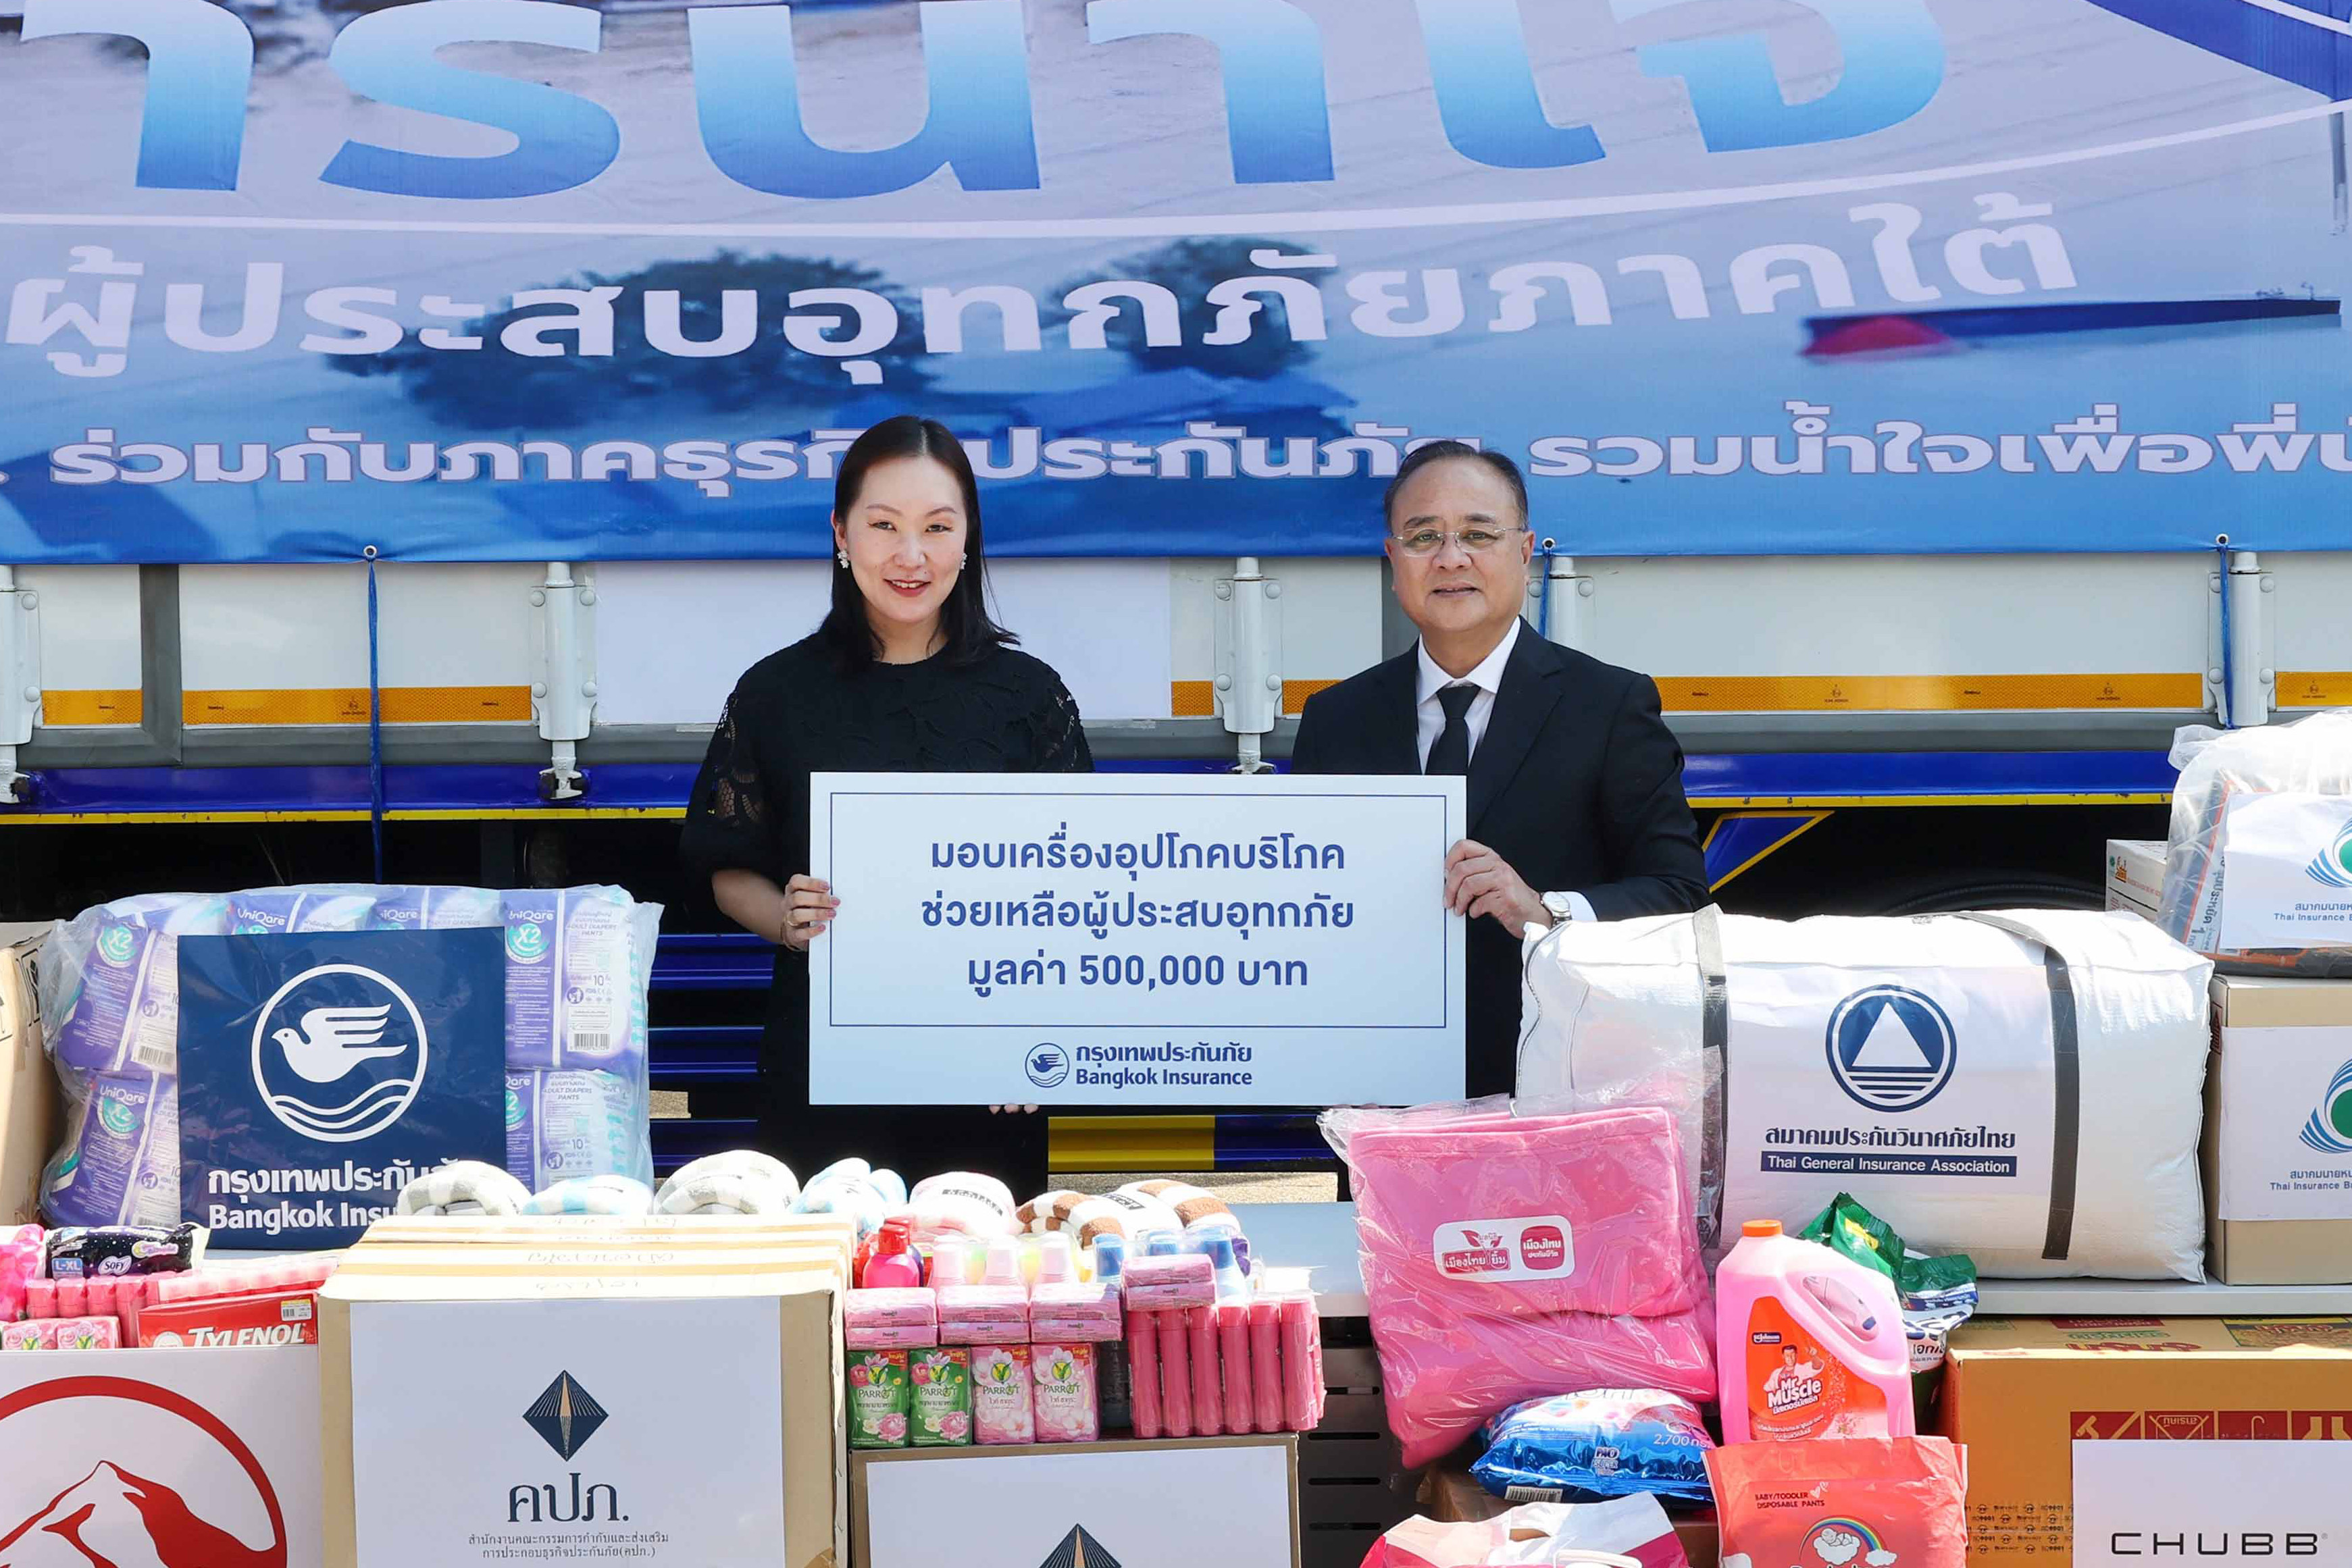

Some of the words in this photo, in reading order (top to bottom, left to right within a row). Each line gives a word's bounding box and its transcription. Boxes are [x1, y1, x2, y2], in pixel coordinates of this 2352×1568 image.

[4, 192, 2078, 385] ผู้ประสบอุทกภัยภาคใต้
[930, 821, 1346, 881] มอบเครื่องอุปโภคบริโภค
[921, 890, 1354, 941] ช่วยเหลือผู้ประสบอุทกภัย
[2273, 913, 2295, 921] Thai
[2298, 913, 2345, 921] Insurance
[967, 948, 1067, 997] มูลค่า
[1079, 955, 1225, 992] 500,000
[1237, 955, 1308, 987] บาท
[593, 974, 605, 986] 10
[1075, 1041, 1252, 1068] กรุงเทพประกันภัย
[1075, 1067, 1158, 1089] Bangkok
[1162, 1069, 1253, 1085] Insurance
[1765, 1125, 2016, 1149] สมาคมประกันวินาศภัยไทย
[572, 1139, 584, 1149] 10
[1767, 1155, 1796, 1169] Thai
[1800, 1155, 1854, 1170] General
[1858, 1157, 1926, 1171] Insurance
[1930, 1158, 2010, 1174] Association
[2294, 1182, 2340, 1190] Insurance
[208, 1199, 334, 1235] Bangkok
[1523, 1238, 1562, 1251] เมืองไทย
[54, 1260, 81, 1271] L-XL
[104, 1260, 125, 1272] SOFY
[983, 1384, 1021, 1395] PARROT
[1043, 1382, 1081, 1394] PARROT
[1781, 1377, 1799, 1390] Mr
[858, 1388, 896, 1399] PARROT
[919, 1386, 958, 1397] PARROT
[1653, 1433, 1690, 1446] 2,700
[507, 1471, 630, 1523] คปภ.
[1756, 1501, 1798, 1509] DISPOSABLE
[468, 1530, 669, 1545] สำนักงานคณะกรรมการกำกับและส่งเสริม
[2111, 1532, 2319, 1556] CHUBB
